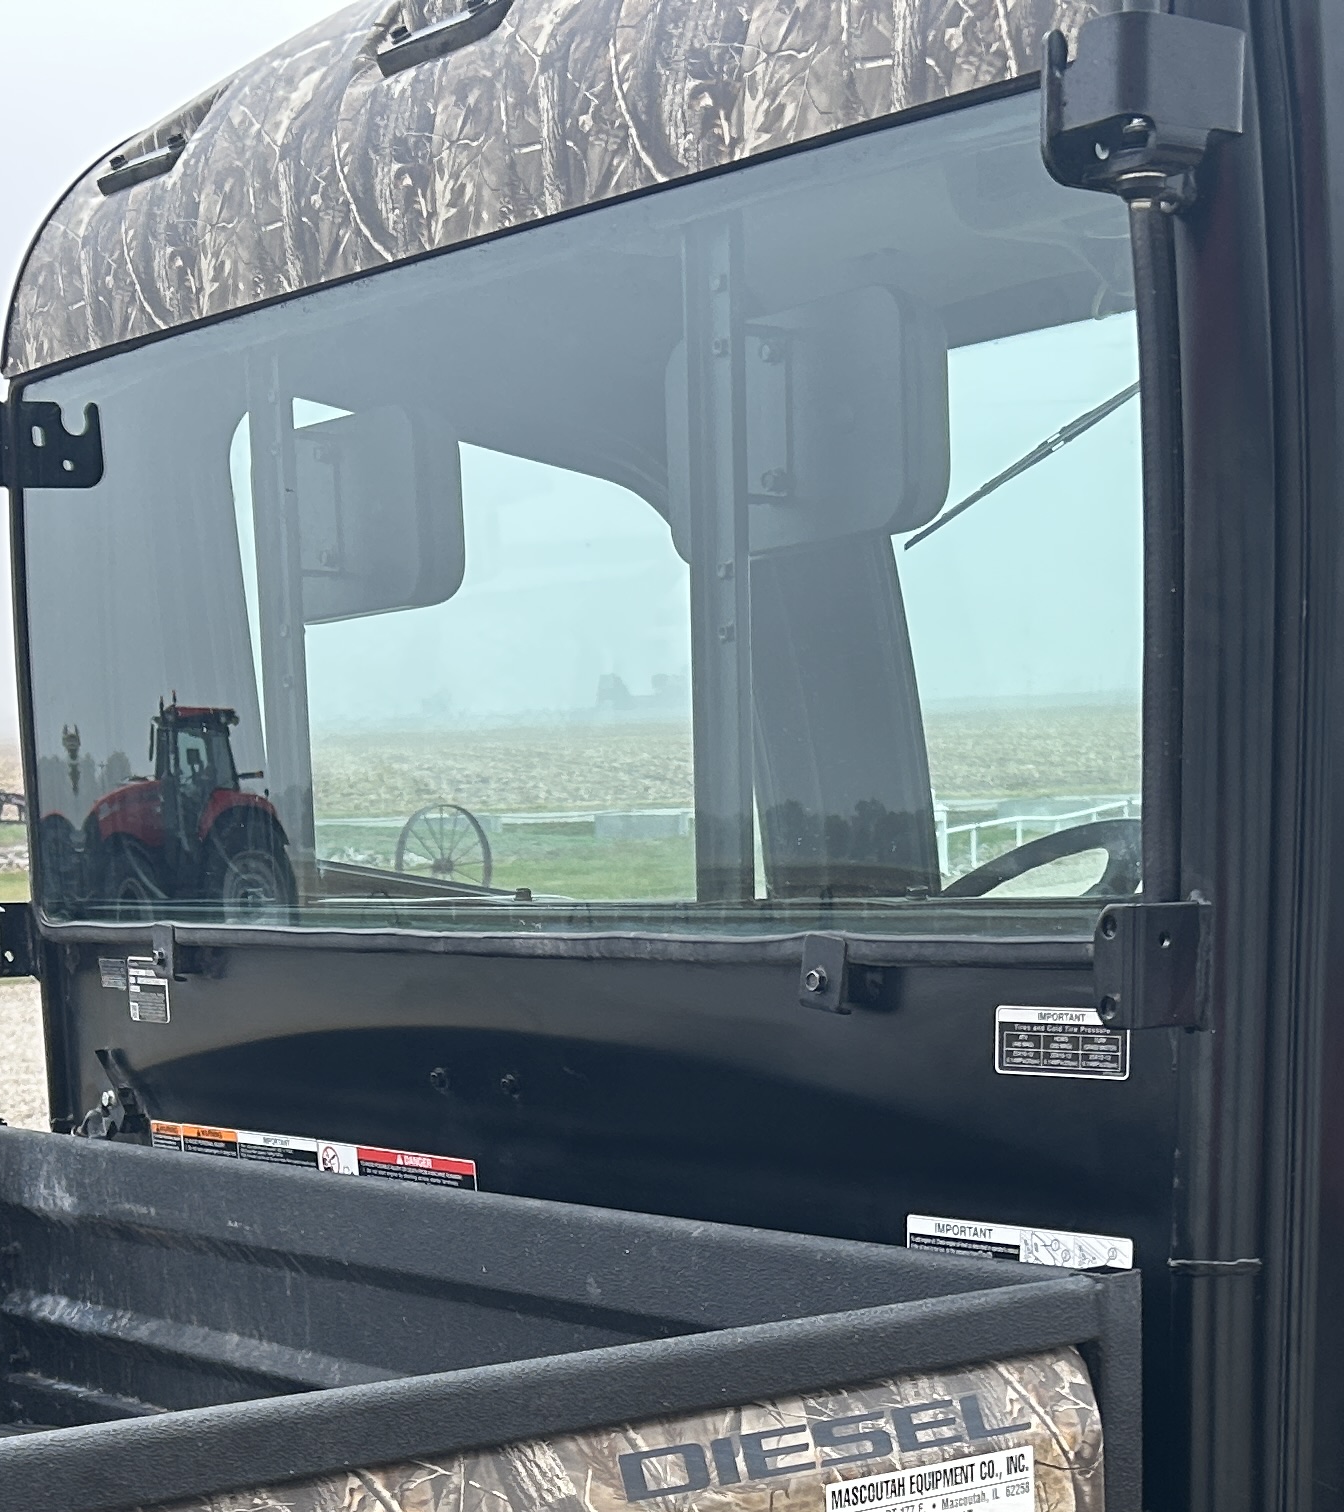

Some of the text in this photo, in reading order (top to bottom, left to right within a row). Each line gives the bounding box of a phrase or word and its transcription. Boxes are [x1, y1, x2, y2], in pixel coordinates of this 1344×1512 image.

[1037, 1011, 1087, 1023] IMPORTANT
[934, 1222, 994, 1240] IMPORTANT
[618, 1395, 1033, 1501] DIESEL
[831, 1476, 906, 1511] MASCOUTAH
[909, 1462, 976, 1495] EQUIPMENT
[1006, 1453, 1030, 1476] INC.
[941, 1490, 990, 1511] Mascoutah,
[991, 1487, 1000, 1500] IL
